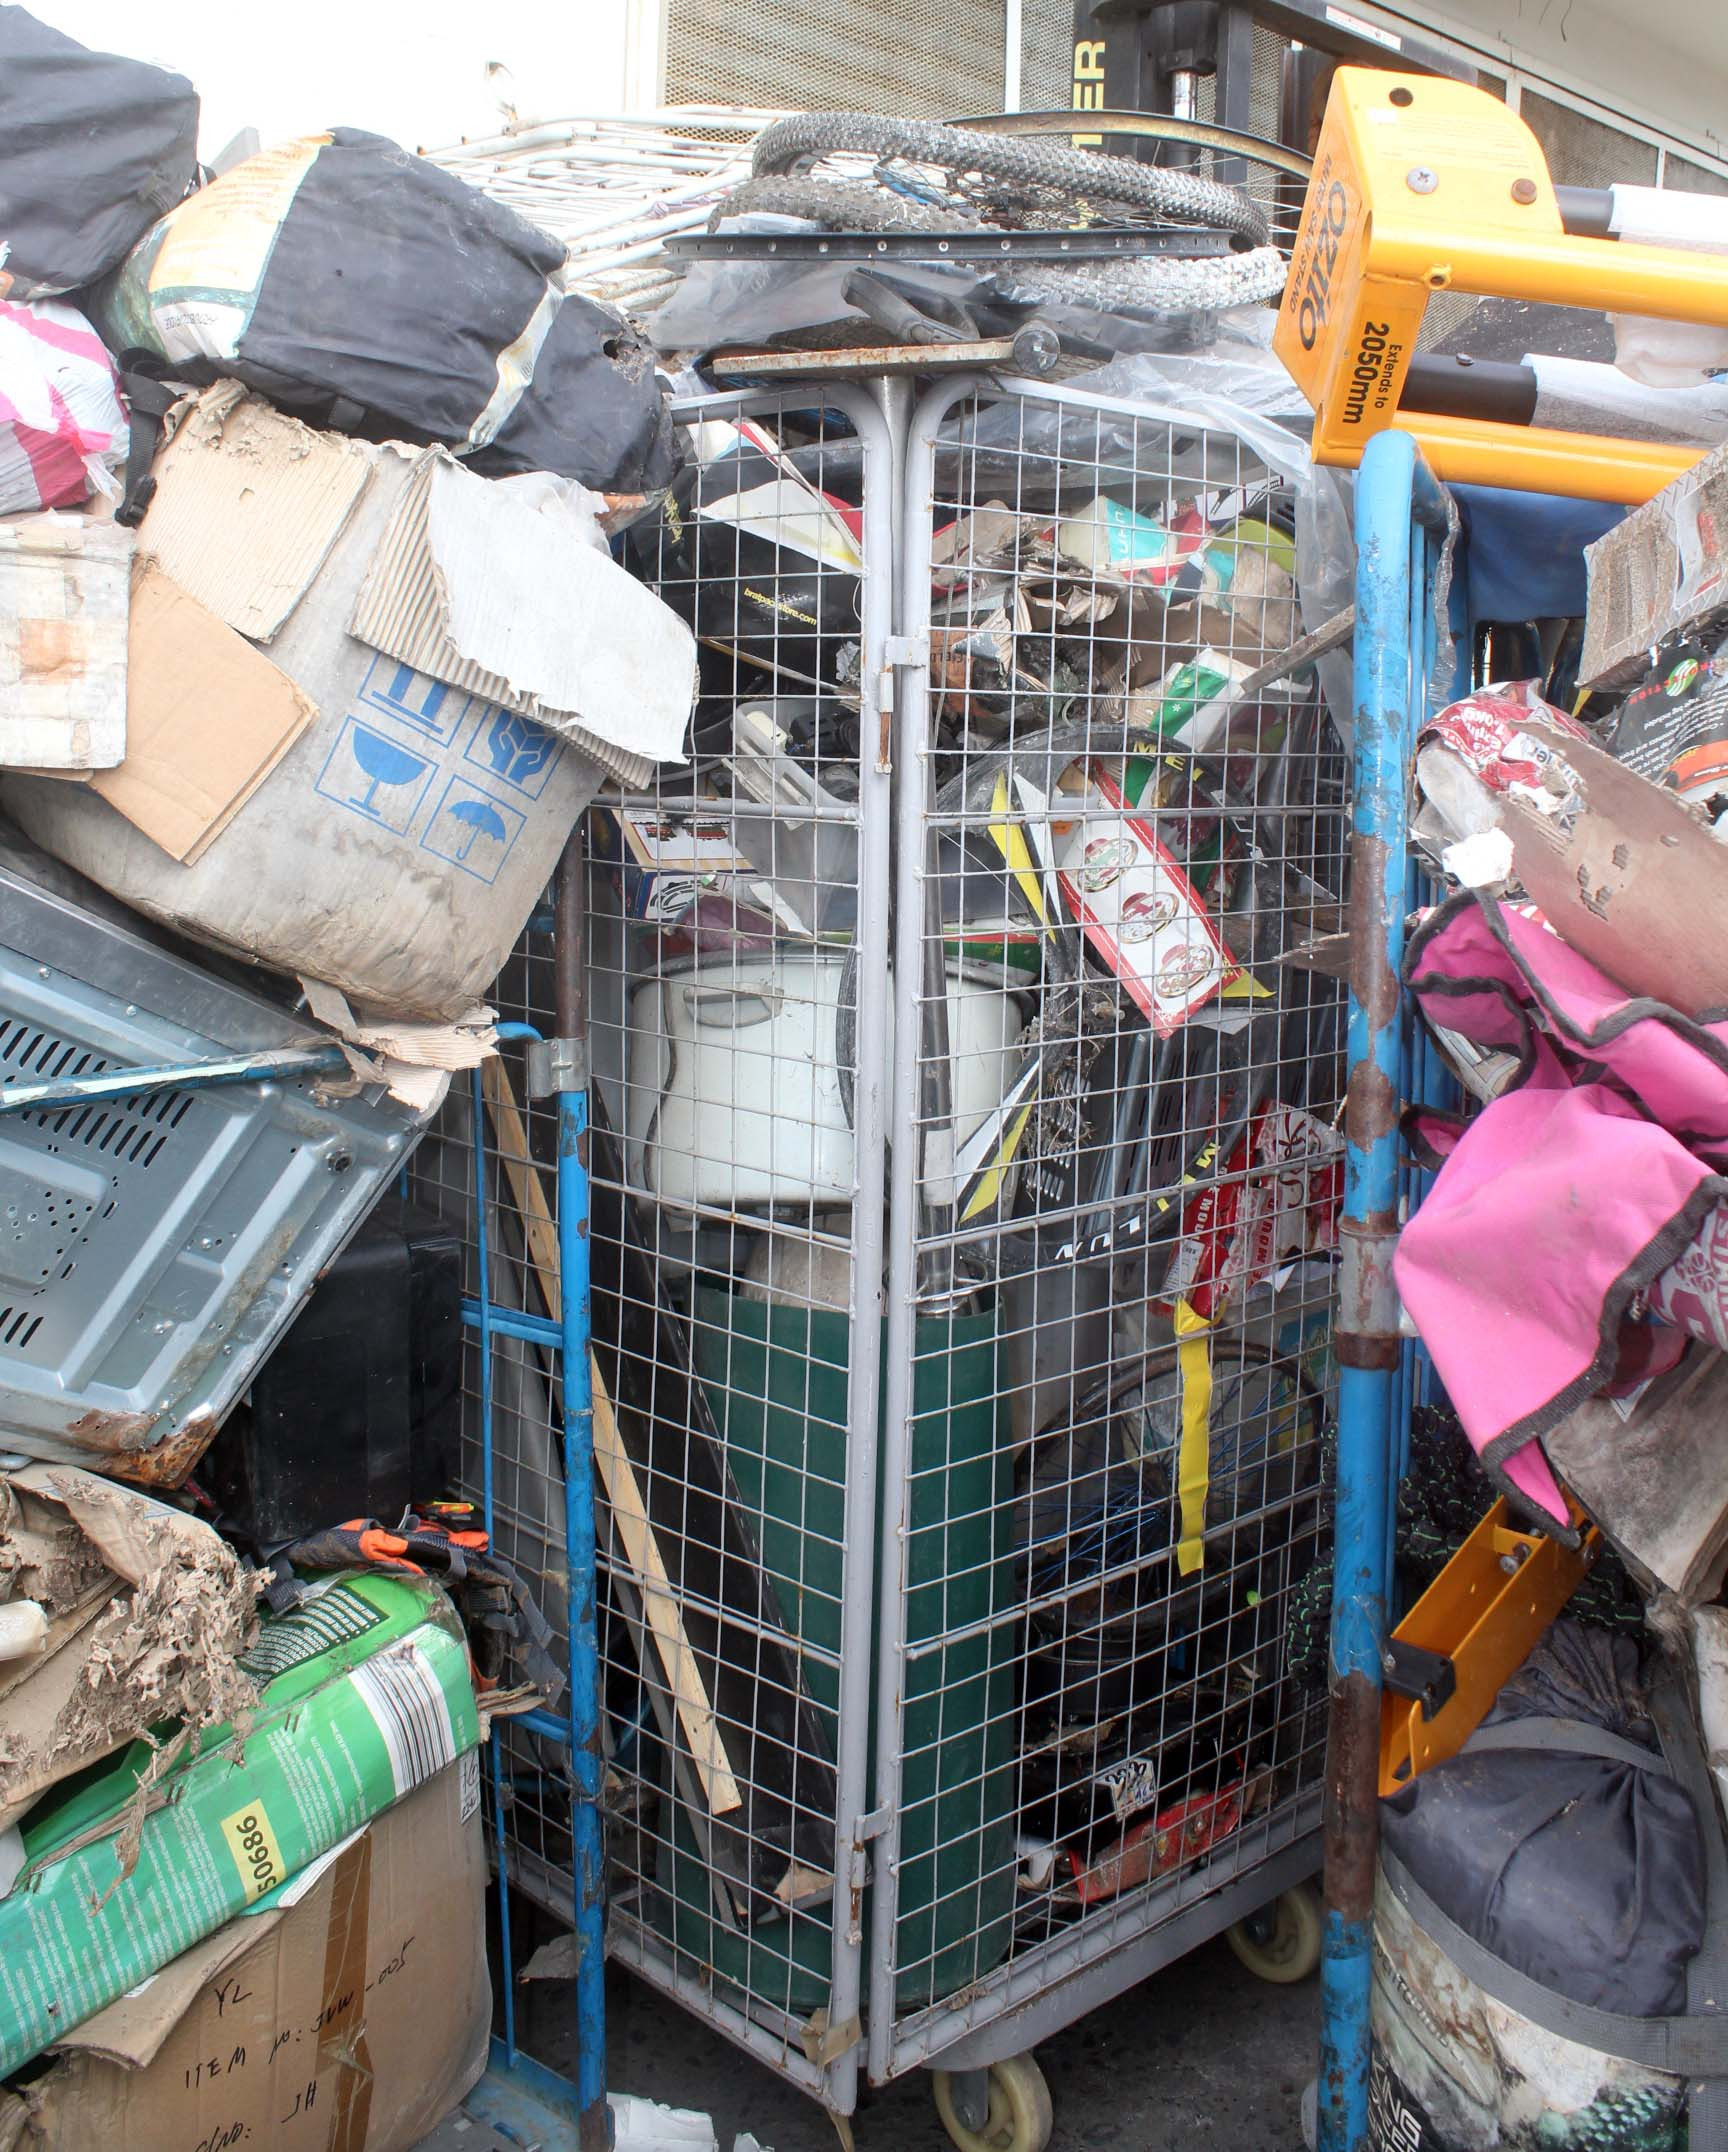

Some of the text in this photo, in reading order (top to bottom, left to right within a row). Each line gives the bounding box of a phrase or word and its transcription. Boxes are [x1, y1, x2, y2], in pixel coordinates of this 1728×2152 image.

[1342, 321, 1390, 425] 2050mm
[1377, 344, 1402, 397] Extends
[237, 1815, 280, 1894] 50686
[184, 2045, 248, 2089] ITEM
